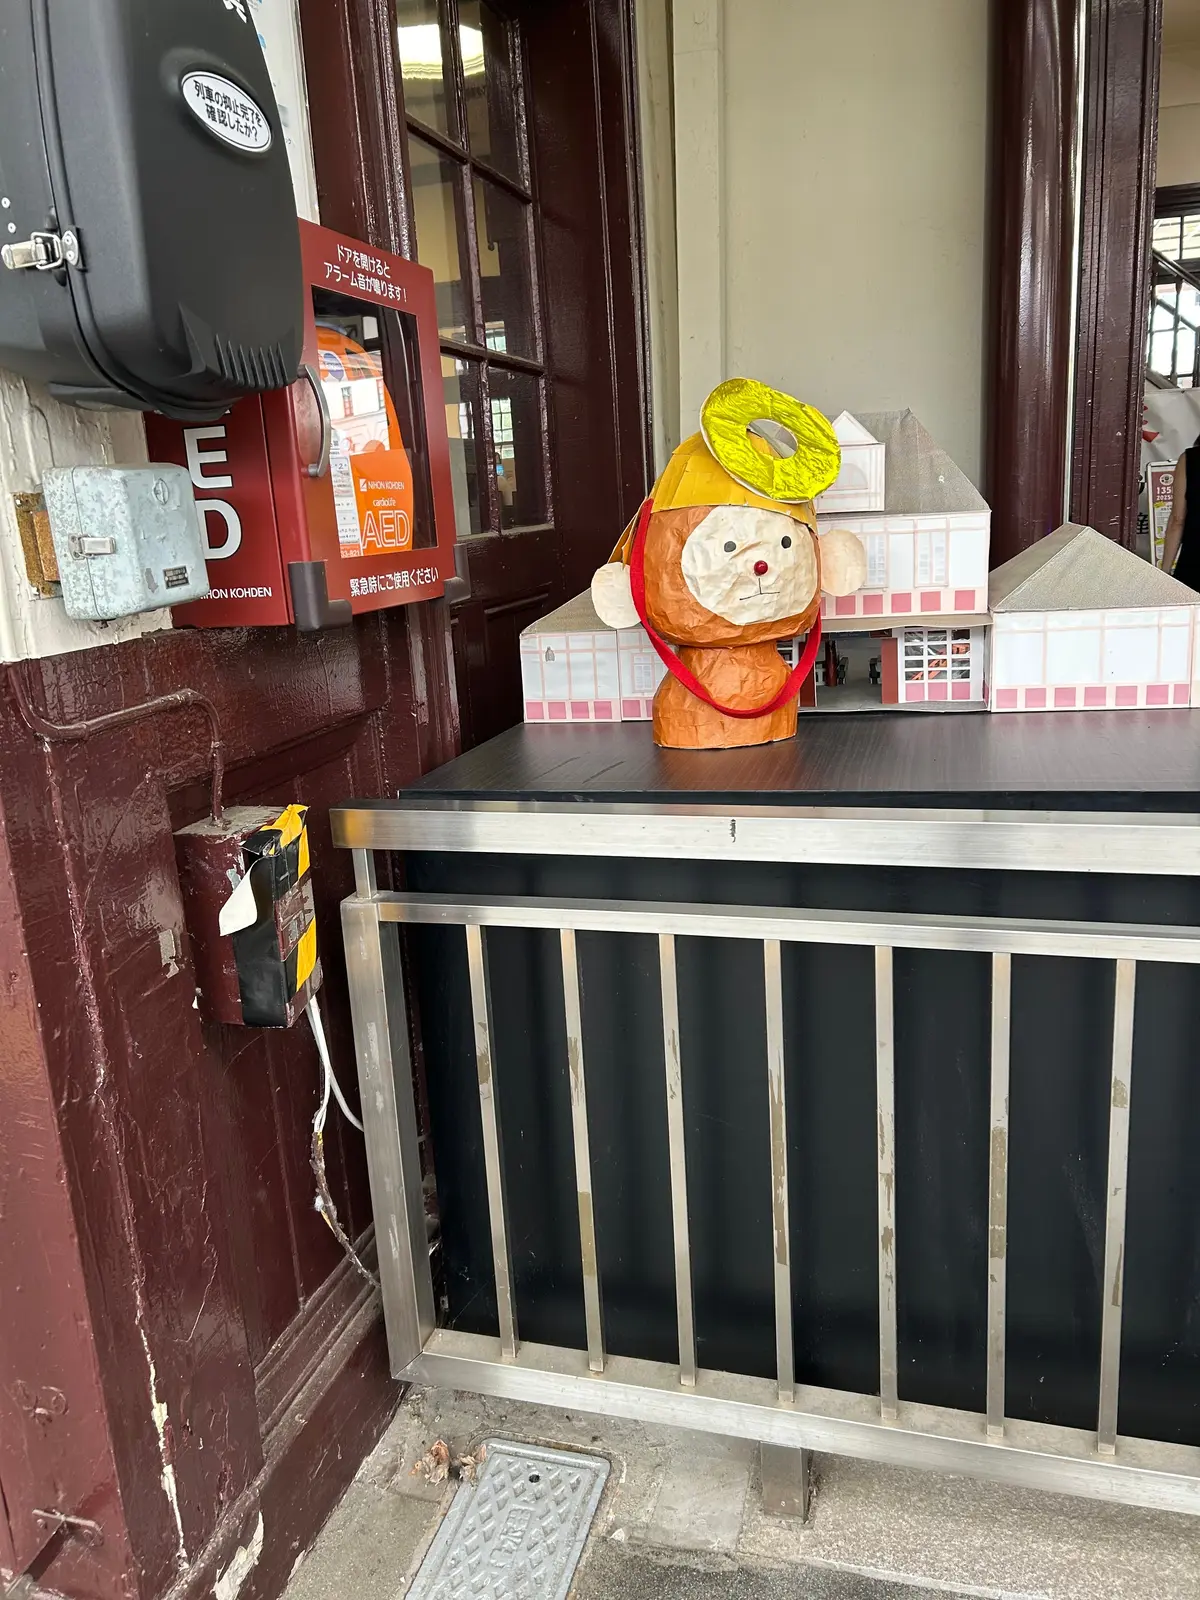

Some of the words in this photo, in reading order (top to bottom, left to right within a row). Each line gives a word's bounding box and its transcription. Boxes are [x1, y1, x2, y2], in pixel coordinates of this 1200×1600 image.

[193, 80, 263, 127] 列車の抑止完了を
[336, 244, 391, 278] ドアを開けると
[323, 261, 407, 302] アラーム音が鳴ります！
[183, 425, 242, 560] ED
[368, 481, 385, 490] NIHON
[386, 481, 404, 490] KOHDEN
[373, 497, 397, 507] cardiolife
[362, 510, 411, 549] AED
[200, 588, 229, 600] HON
[229, 586, 272, 599] KOHDEN
[349, 567, 439, 597] 緊急時にご使用ください
